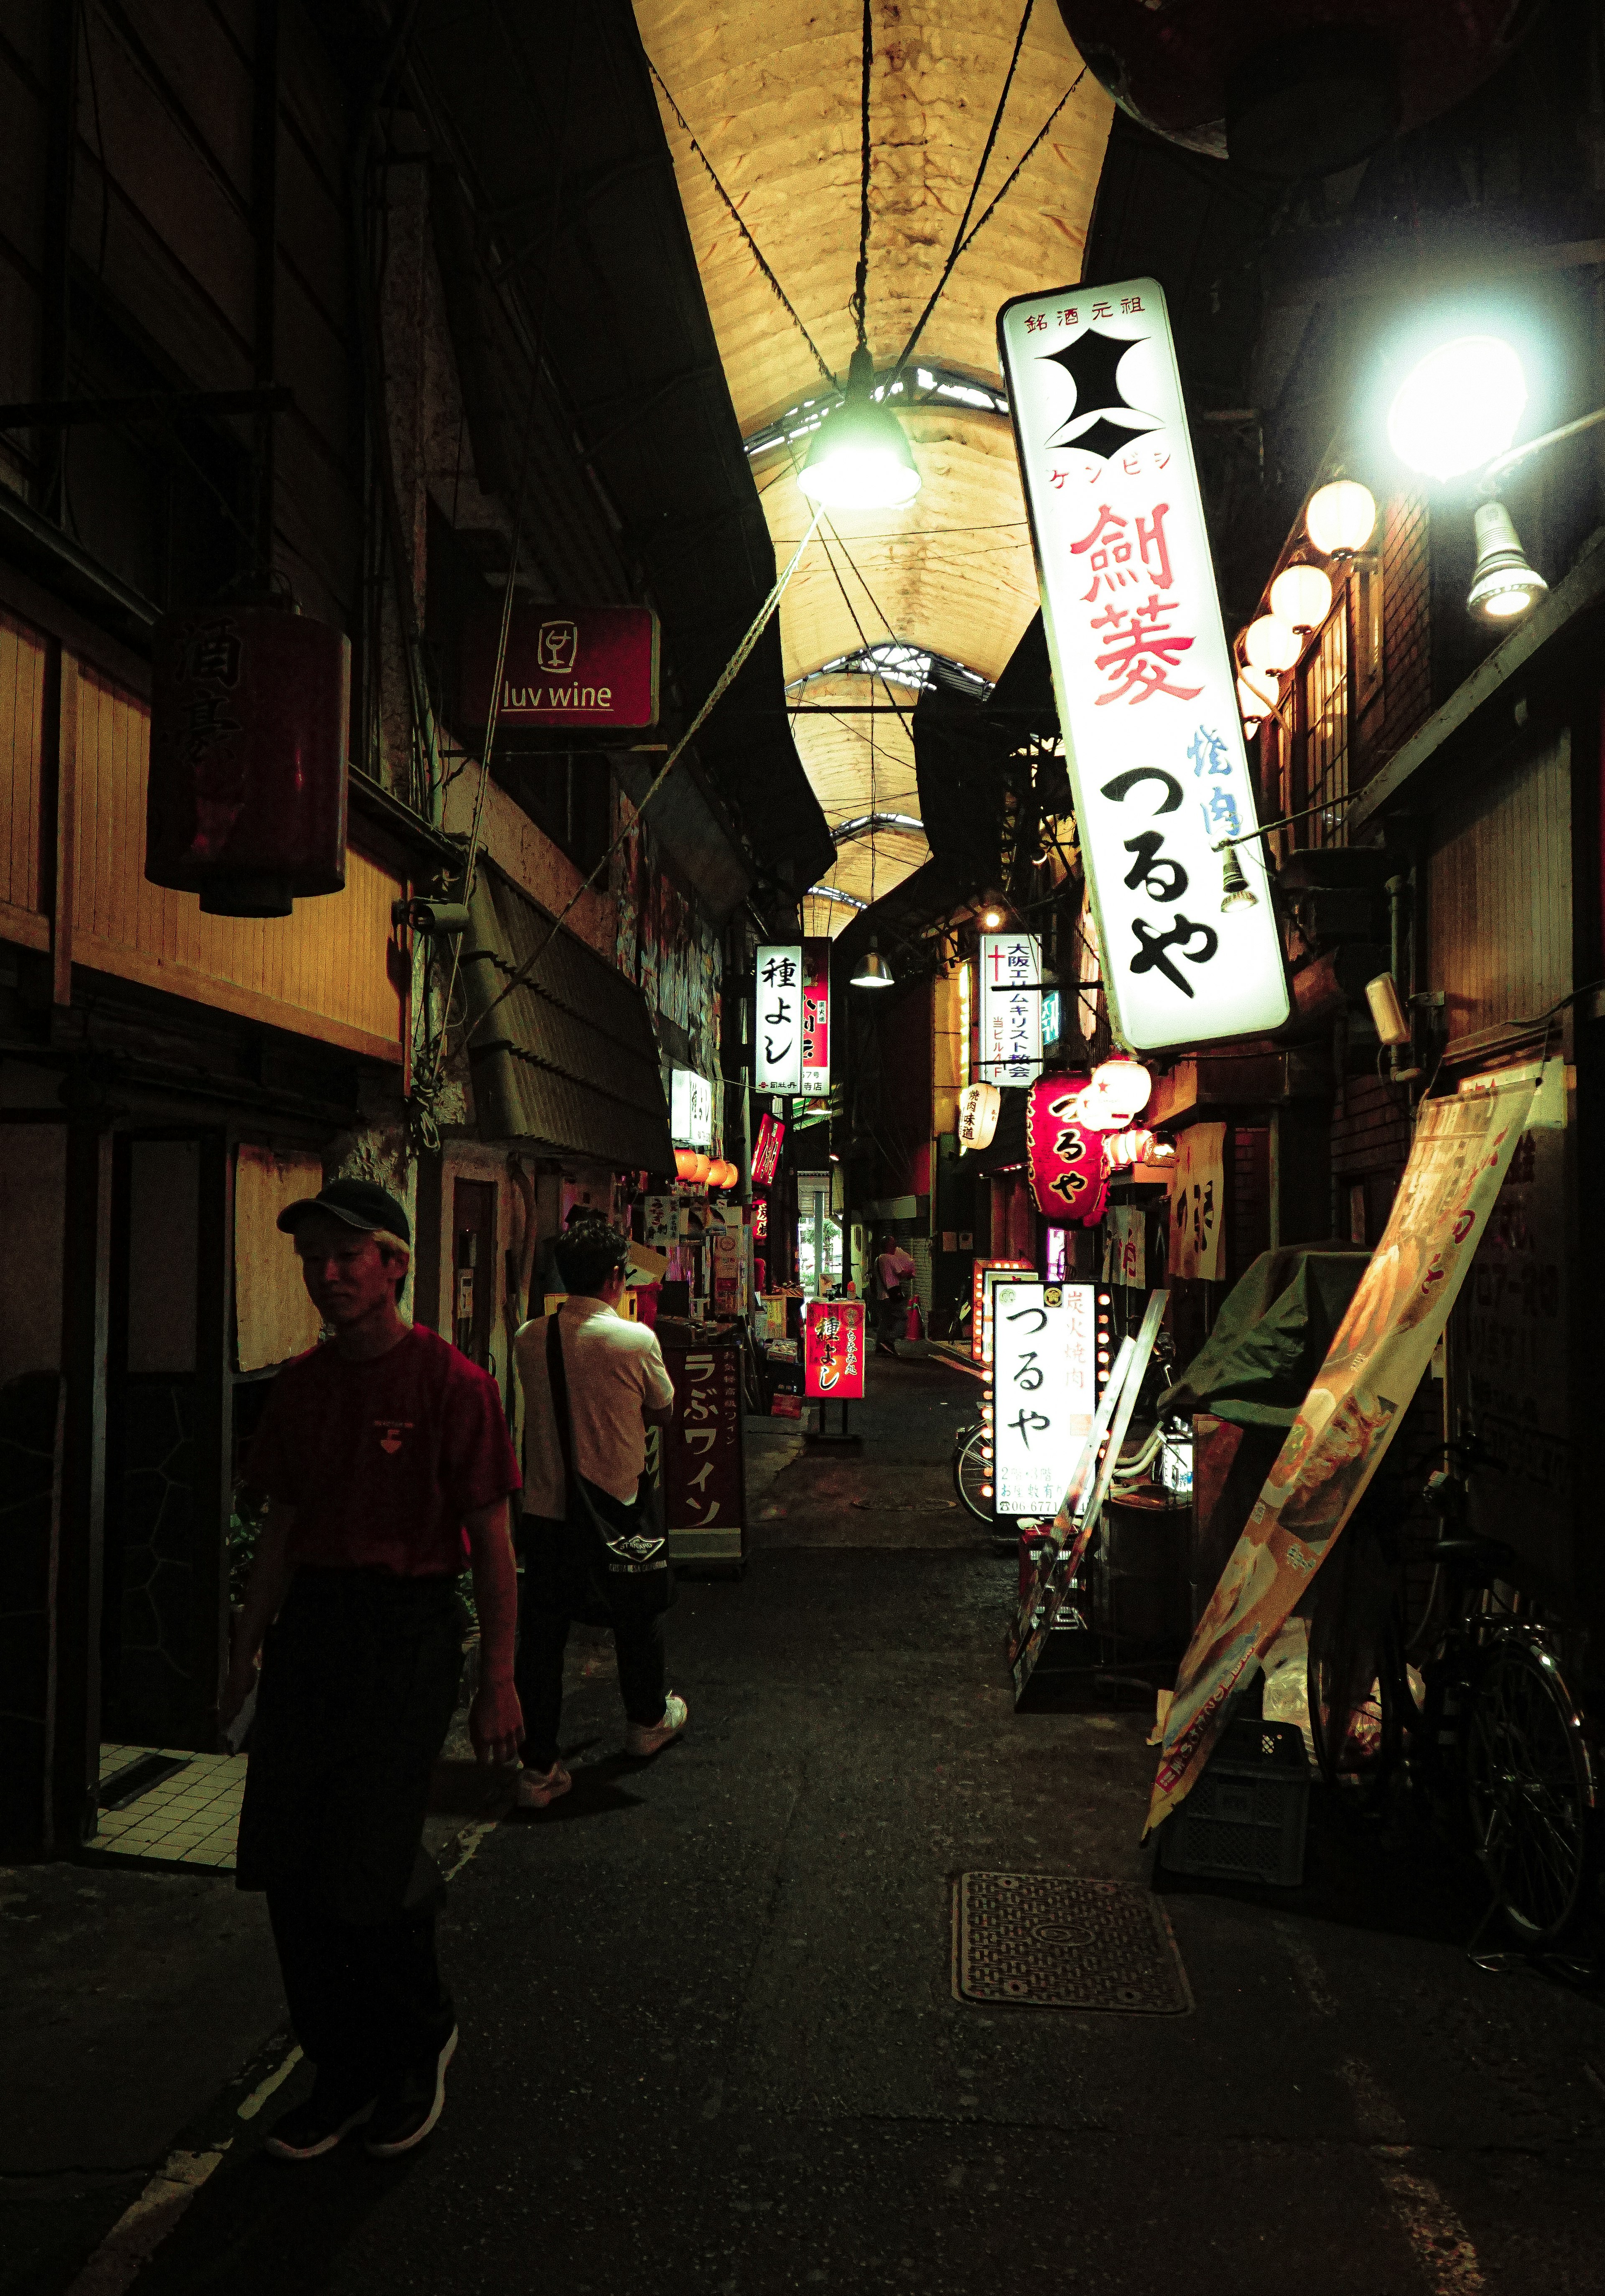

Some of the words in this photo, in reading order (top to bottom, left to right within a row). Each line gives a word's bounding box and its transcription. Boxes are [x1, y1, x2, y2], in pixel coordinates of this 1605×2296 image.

[1024, 296, 1145, 333] 銘酒元祖
[1049, 452, 1171, 489] ケンビシ
[504, 680, 543, 707] luv
[549, 681, 612, 707] wine
[1100, 766, 1219, 999] つるや
[761, 956, 797, 1065] 種よし
[962, 1089, 980, 1140] 焼肉味道
[814, 1316, 841, 1391] 種よし
[1005, 1307, 1051, 1452] つるや
[683, 1354, 720, 1528] ラぶワイン
